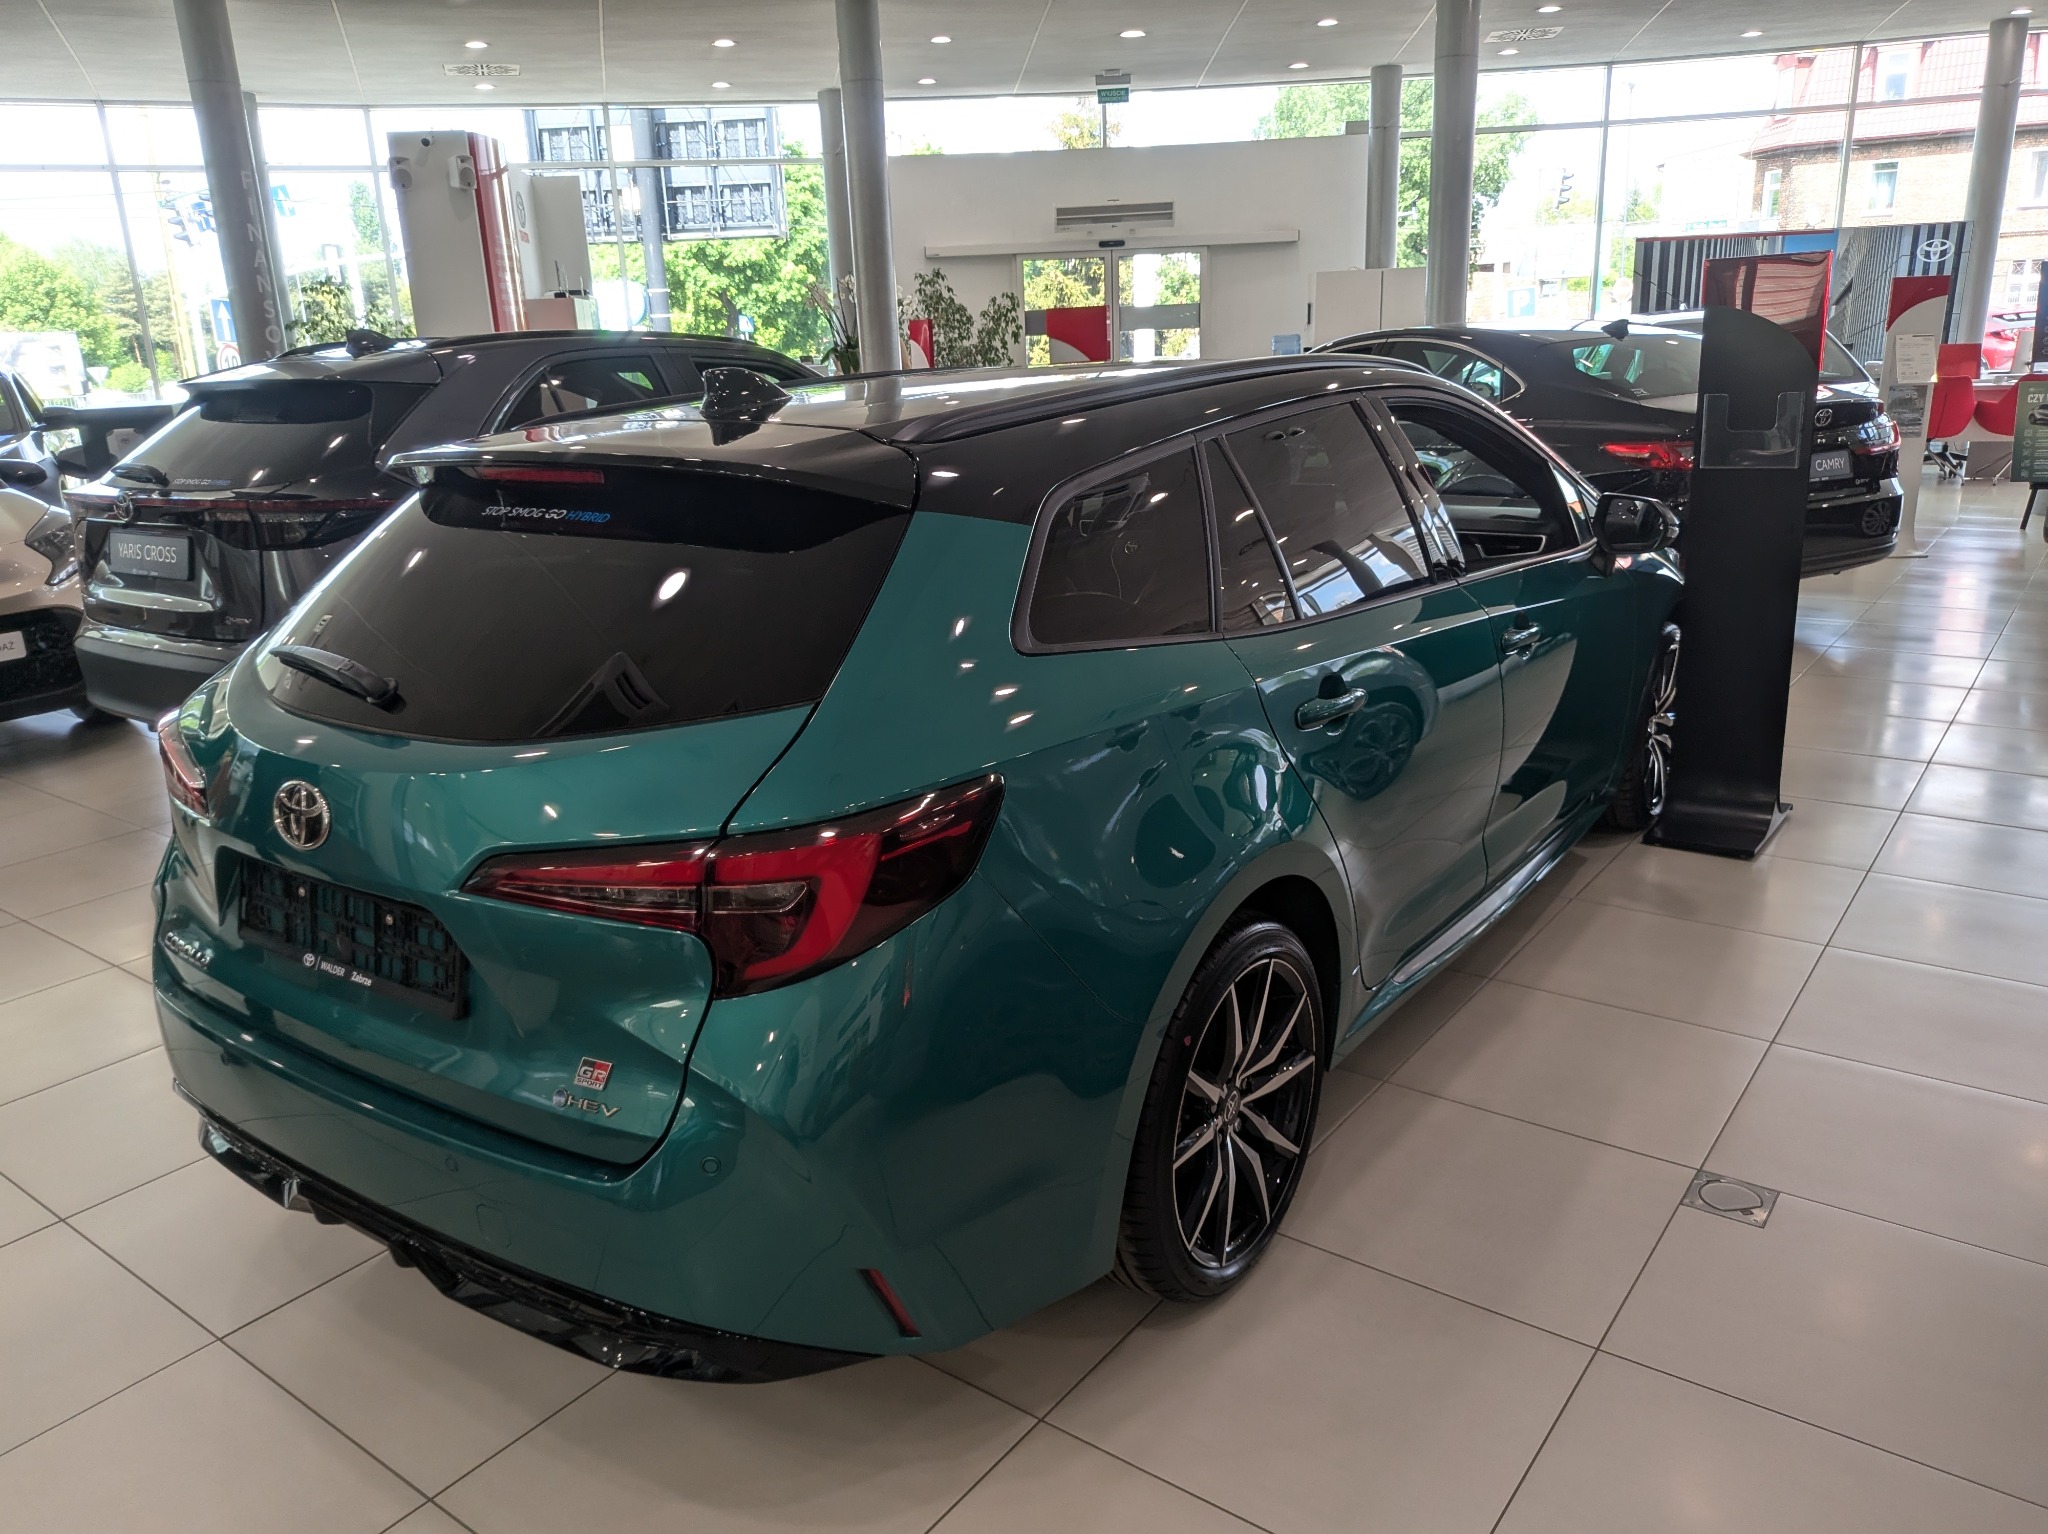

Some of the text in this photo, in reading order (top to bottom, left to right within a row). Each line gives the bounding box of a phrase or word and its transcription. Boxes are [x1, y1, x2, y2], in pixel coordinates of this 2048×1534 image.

[241, 170, 282, 358] FINANSO
[1513, 290, 1531, 316] P
[2028, 394, 2045, 403] CZY
[1815, 457, 1845, 471] CAMRY
[481, 506, 611, 523] STOP SMOG GO HYBRID
[118, 542, 177, 563] YARIS CROSS
[320, 961, 372, 986] WALDER Zabrze
[577, 1078, 603, 1087] SPORT
[580, 1066, 607, 1083] GR
[567, 1095, 621, 1117] HEV
